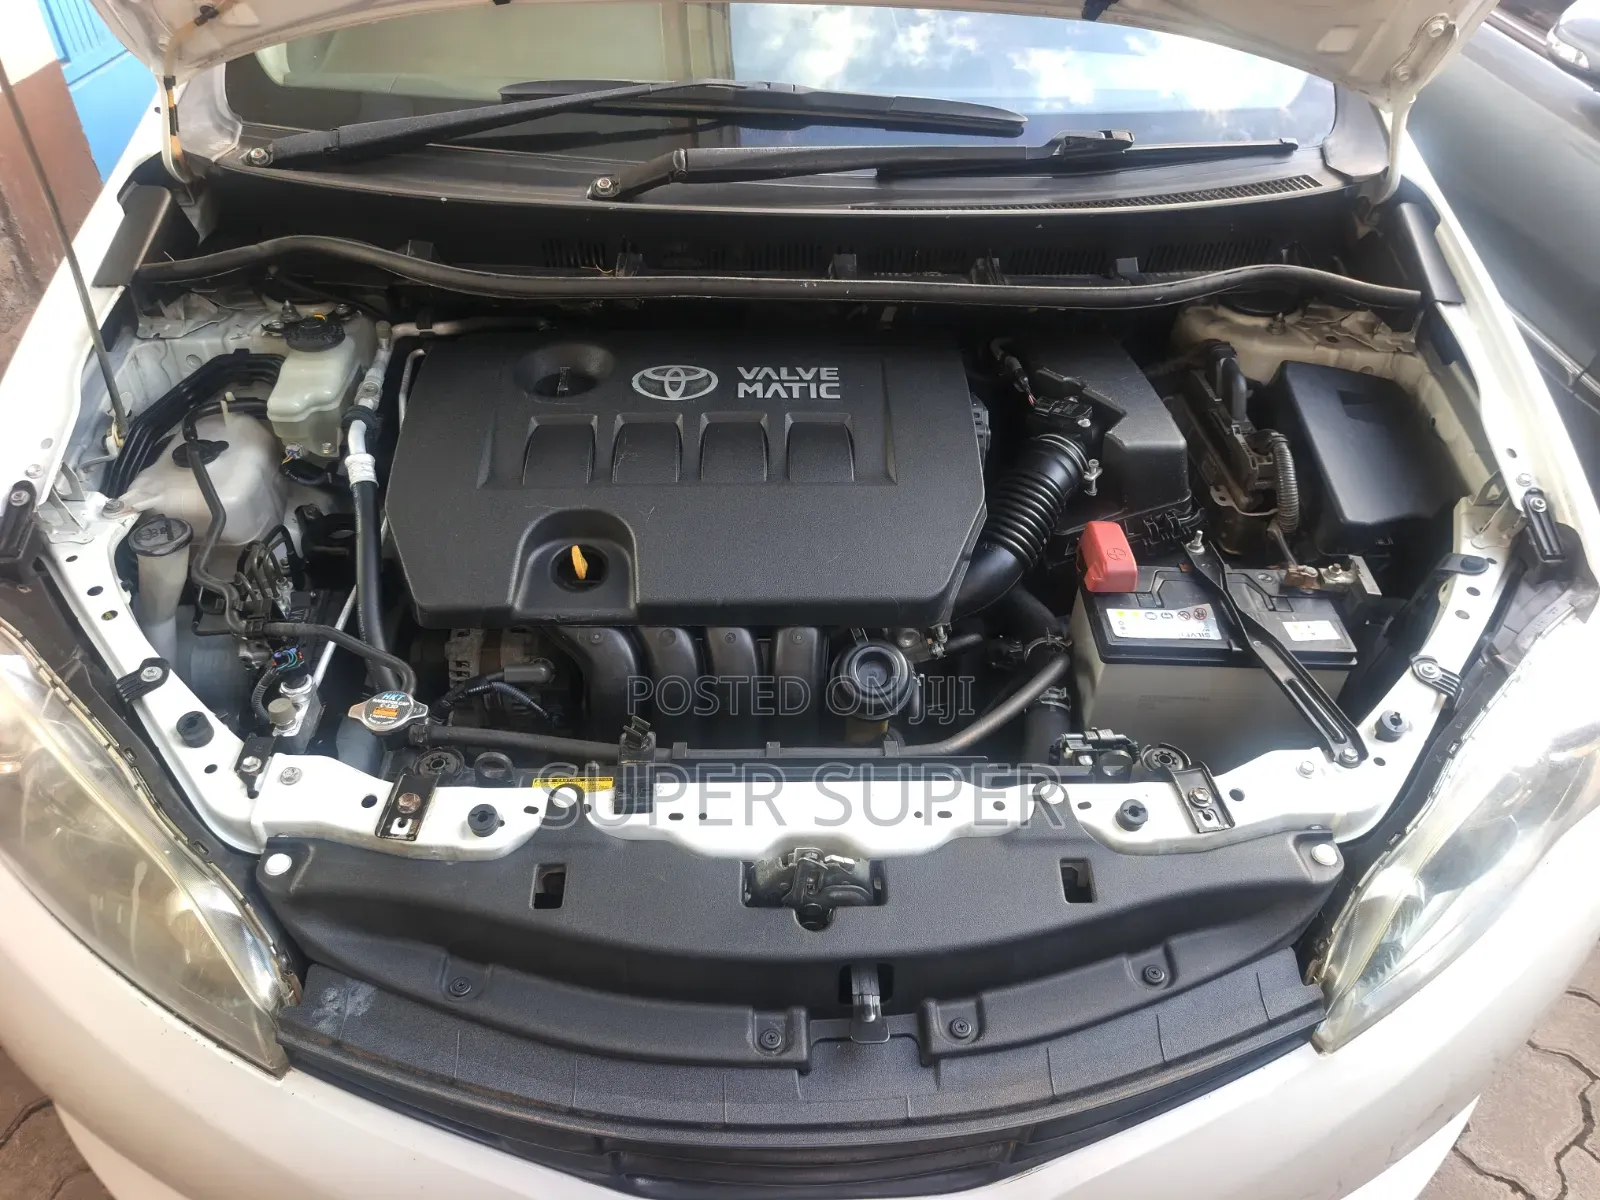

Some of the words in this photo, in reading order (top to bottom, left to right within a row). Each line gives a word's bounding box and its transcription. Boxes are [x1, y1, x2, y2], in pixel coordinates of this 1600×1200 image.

[737, 366, 840, 381] VALVE
[737, 382, 841, 399] MATIC
[382, 693, 406, 701] HKT
